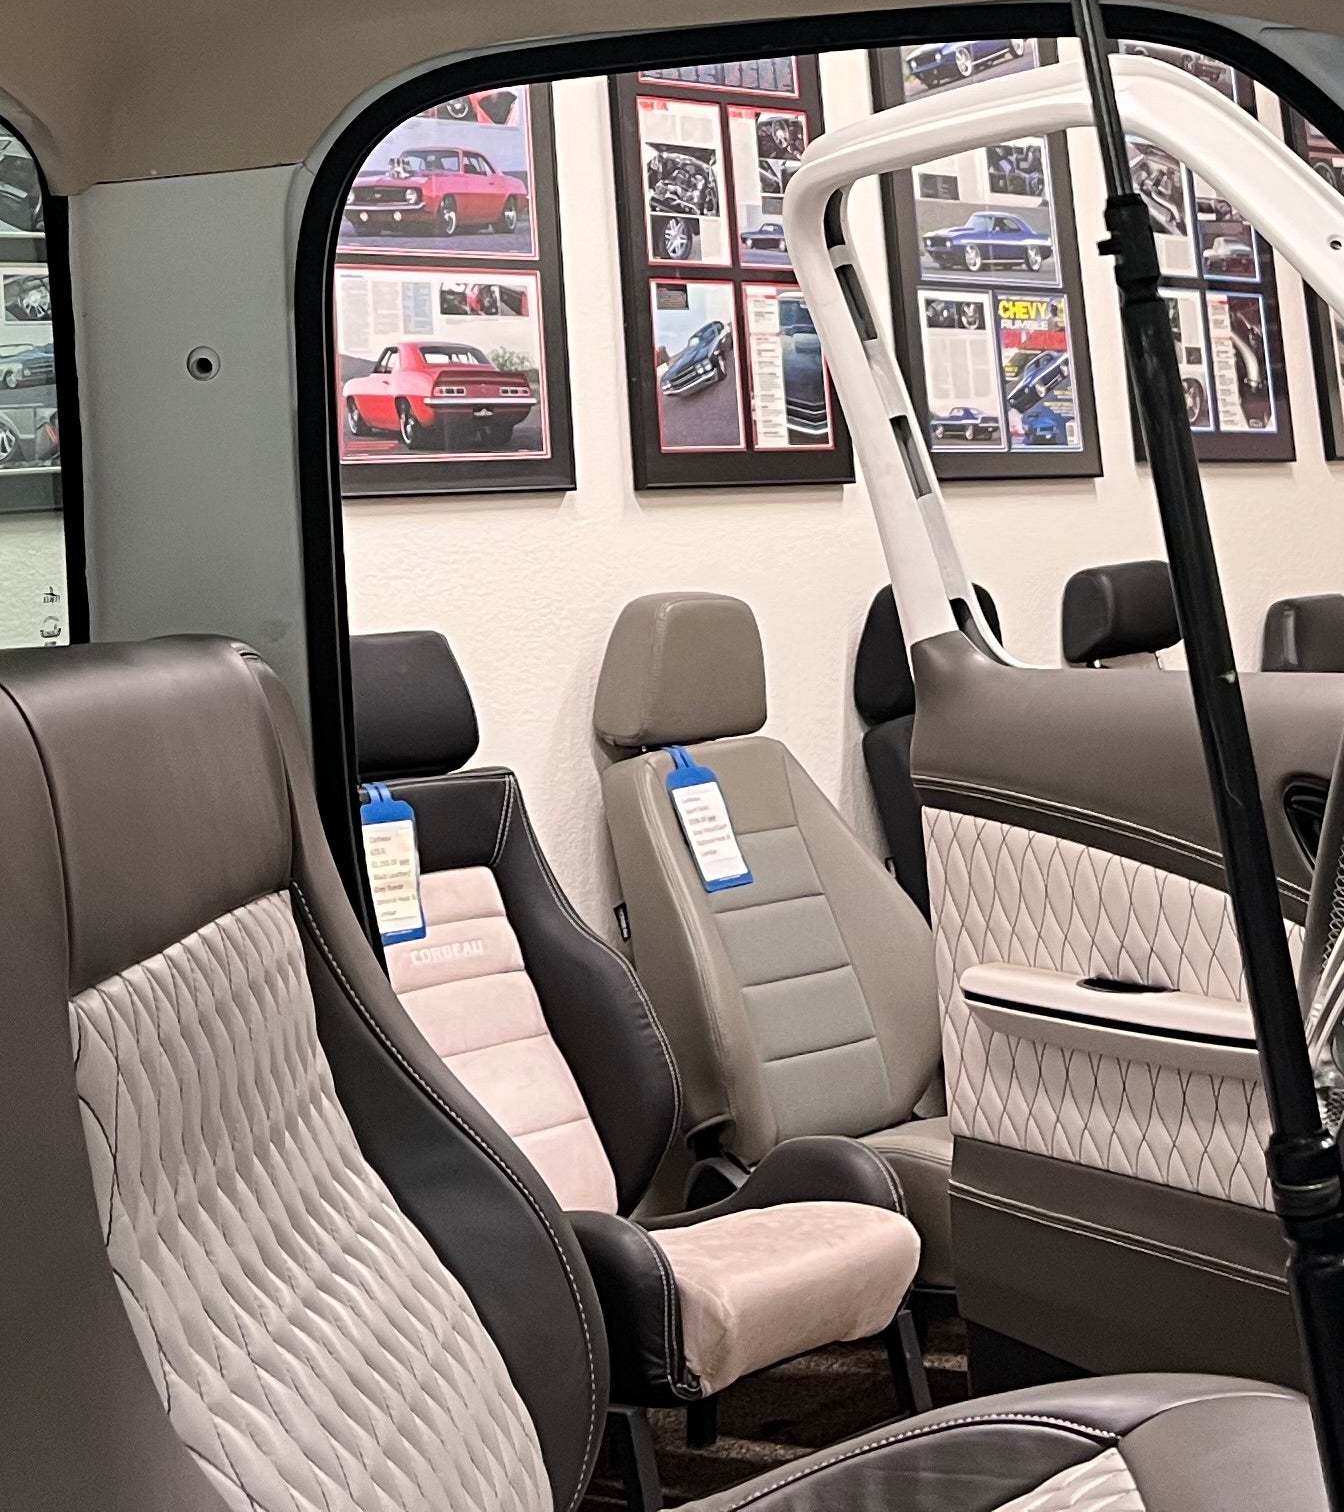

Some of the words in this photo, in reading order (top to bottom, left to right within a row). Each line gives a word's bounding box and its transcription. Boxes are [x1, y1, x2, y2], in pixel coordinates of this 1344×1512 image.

[998, 300, 1048, 320] CHEVY
[1000, 319, 1049, 331] RUMBLE
[410, 939, 484, 966] CORBEAU
